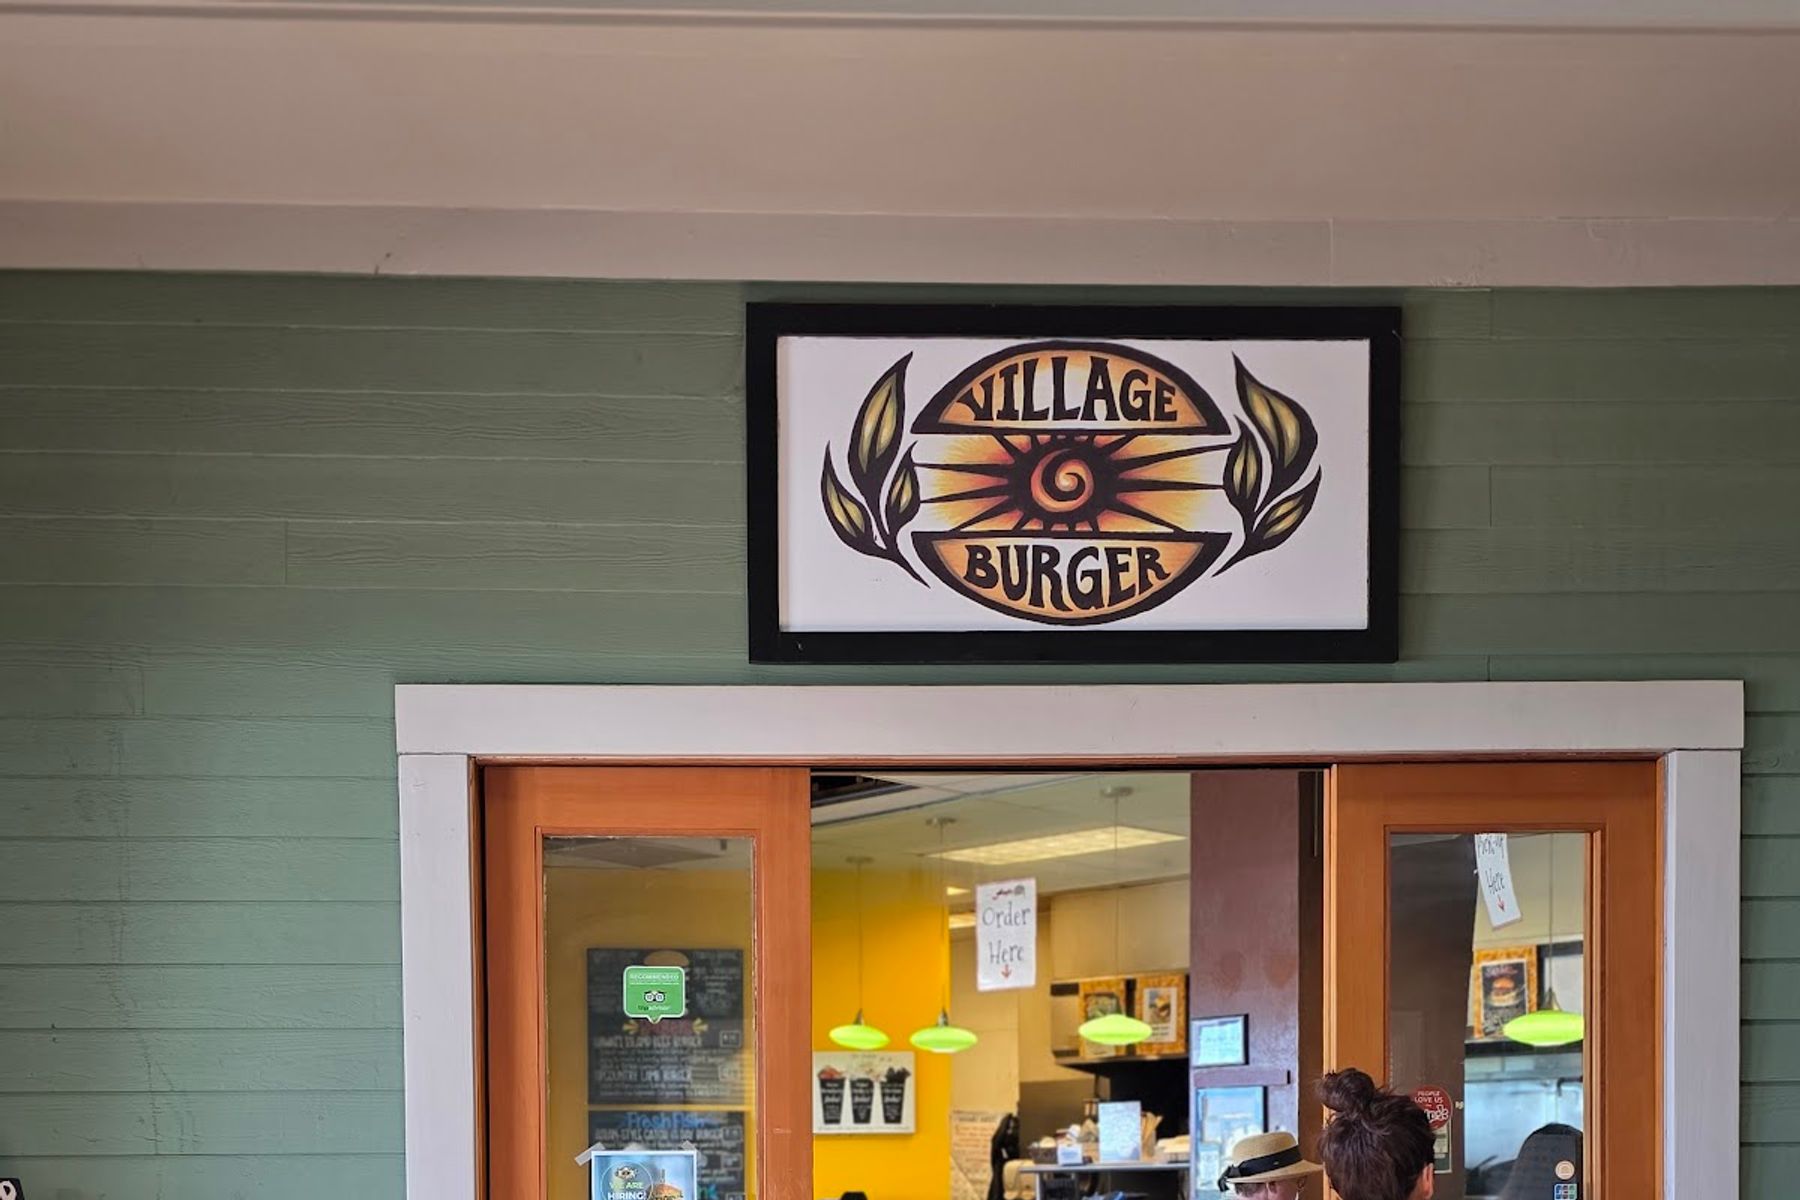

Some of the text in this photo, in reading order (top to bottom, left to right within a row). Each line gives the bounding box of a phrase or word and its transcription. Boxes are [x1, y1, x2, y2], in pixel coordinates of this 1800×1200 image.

[957, 356, 1178, 423] VILLAGE
[963, 543, 1170, 611] BURGER
[982, 901, 1031, 929] Order
[988, 940, 1025, 964] Here
[1415, 1096, 1433, 1104] LOVE
[607, 1191, 647, 1200] HIRING!
[609, 1181, 645, 1190] WE ARE
